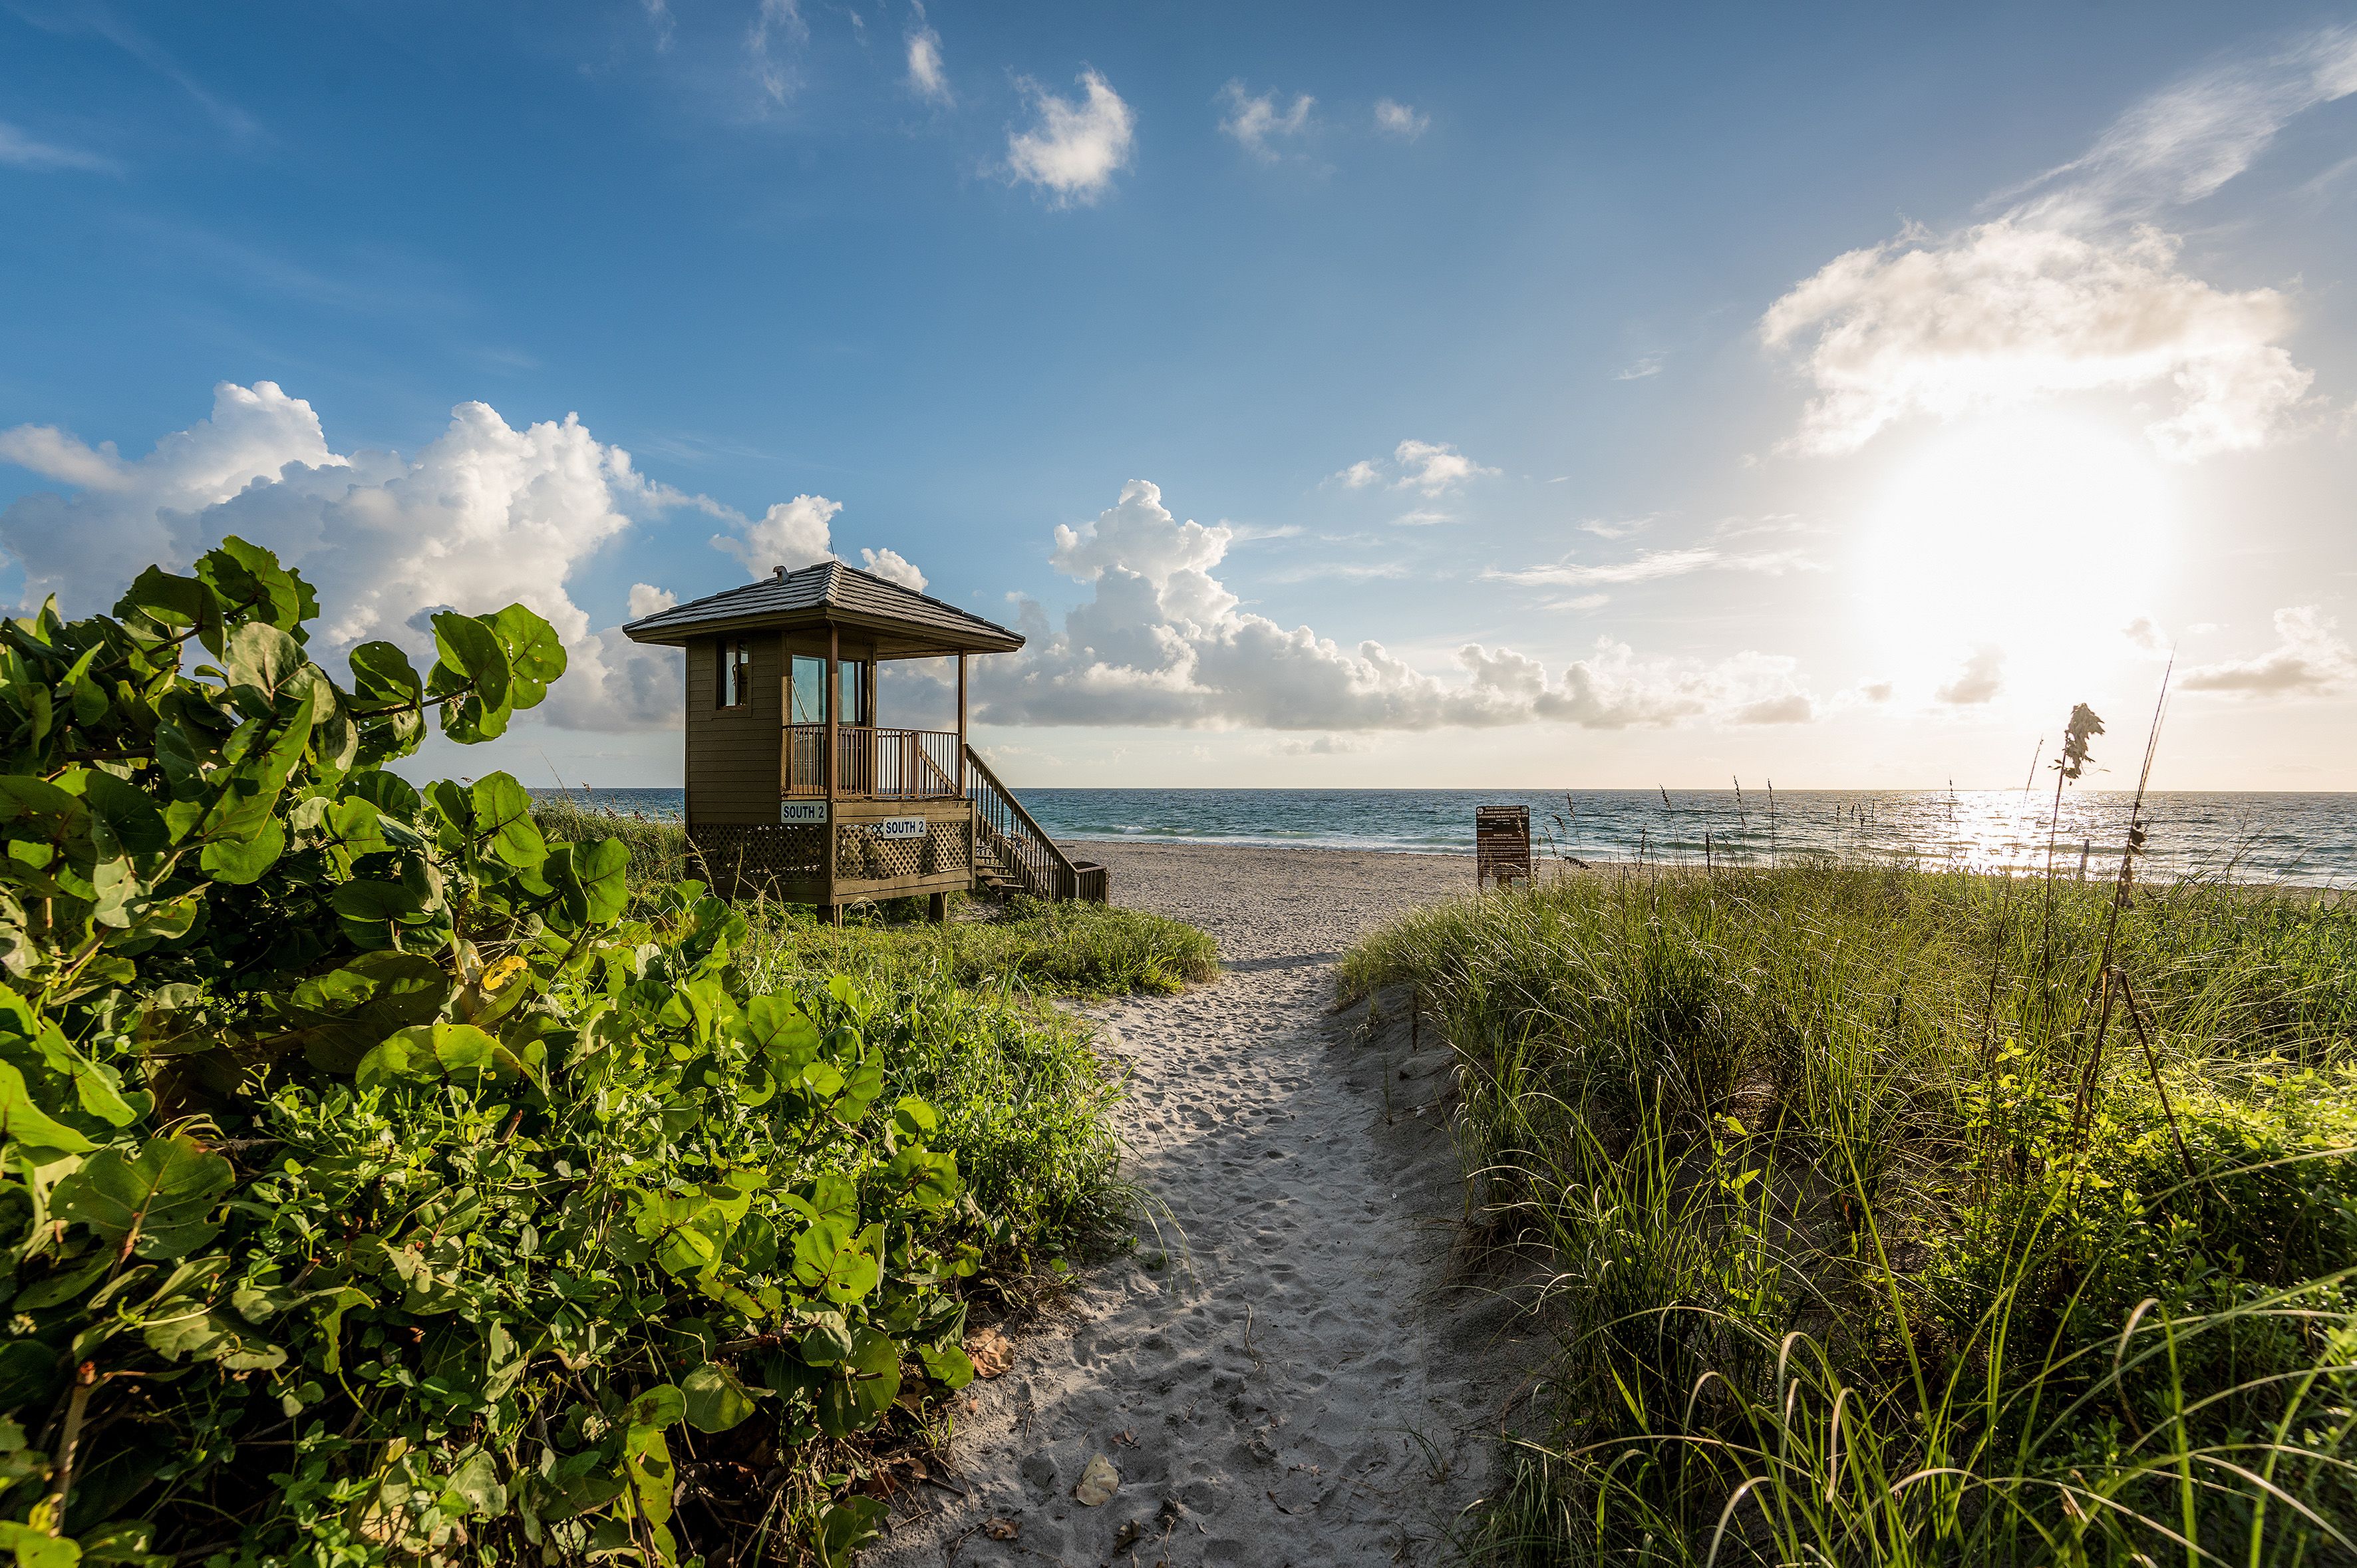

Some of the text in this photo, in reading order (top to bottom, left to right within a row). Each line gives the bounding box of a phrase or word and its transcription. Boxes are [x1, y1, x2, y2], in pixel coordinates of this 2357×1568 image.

[783, 805, 824, 819] SOUTH 2
[885, 820, 924, 834] SOUTH 2
